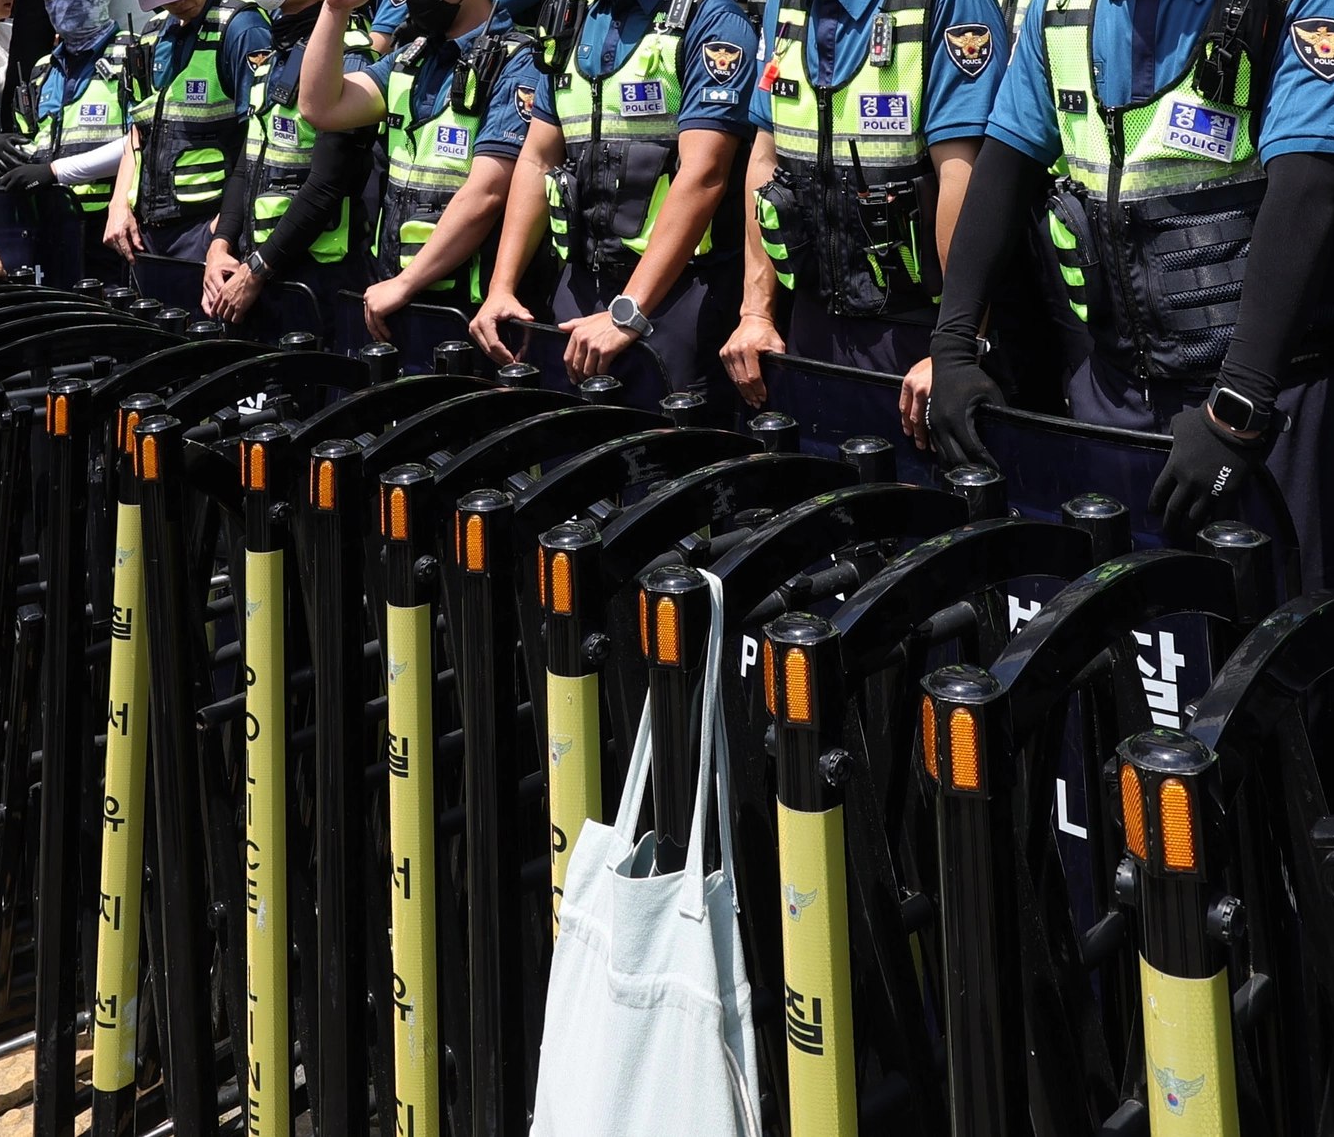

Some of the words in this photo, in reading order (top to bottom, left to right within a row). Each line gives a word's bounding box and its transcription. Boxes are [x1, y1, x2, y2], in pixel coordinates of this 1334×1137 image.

[623, 84, 659, 101] 경찰
[625, 104, 661, 112] POLICE
[863, 97, 904, 117] 경찰
[863, 120, 906, 130] POLICE
[1174, 105, 1231, 140] 경찰
[274, 131, 295, 142] POLICE
[439, 127, 467, 145] 경찰
[1170, 131, 1227, 155] POLICE
[437, 145, 465, 155] POLICE
[1211, 466, 1232, 496] POLICE
[96, 604, 132, 1030] 질서유지선
